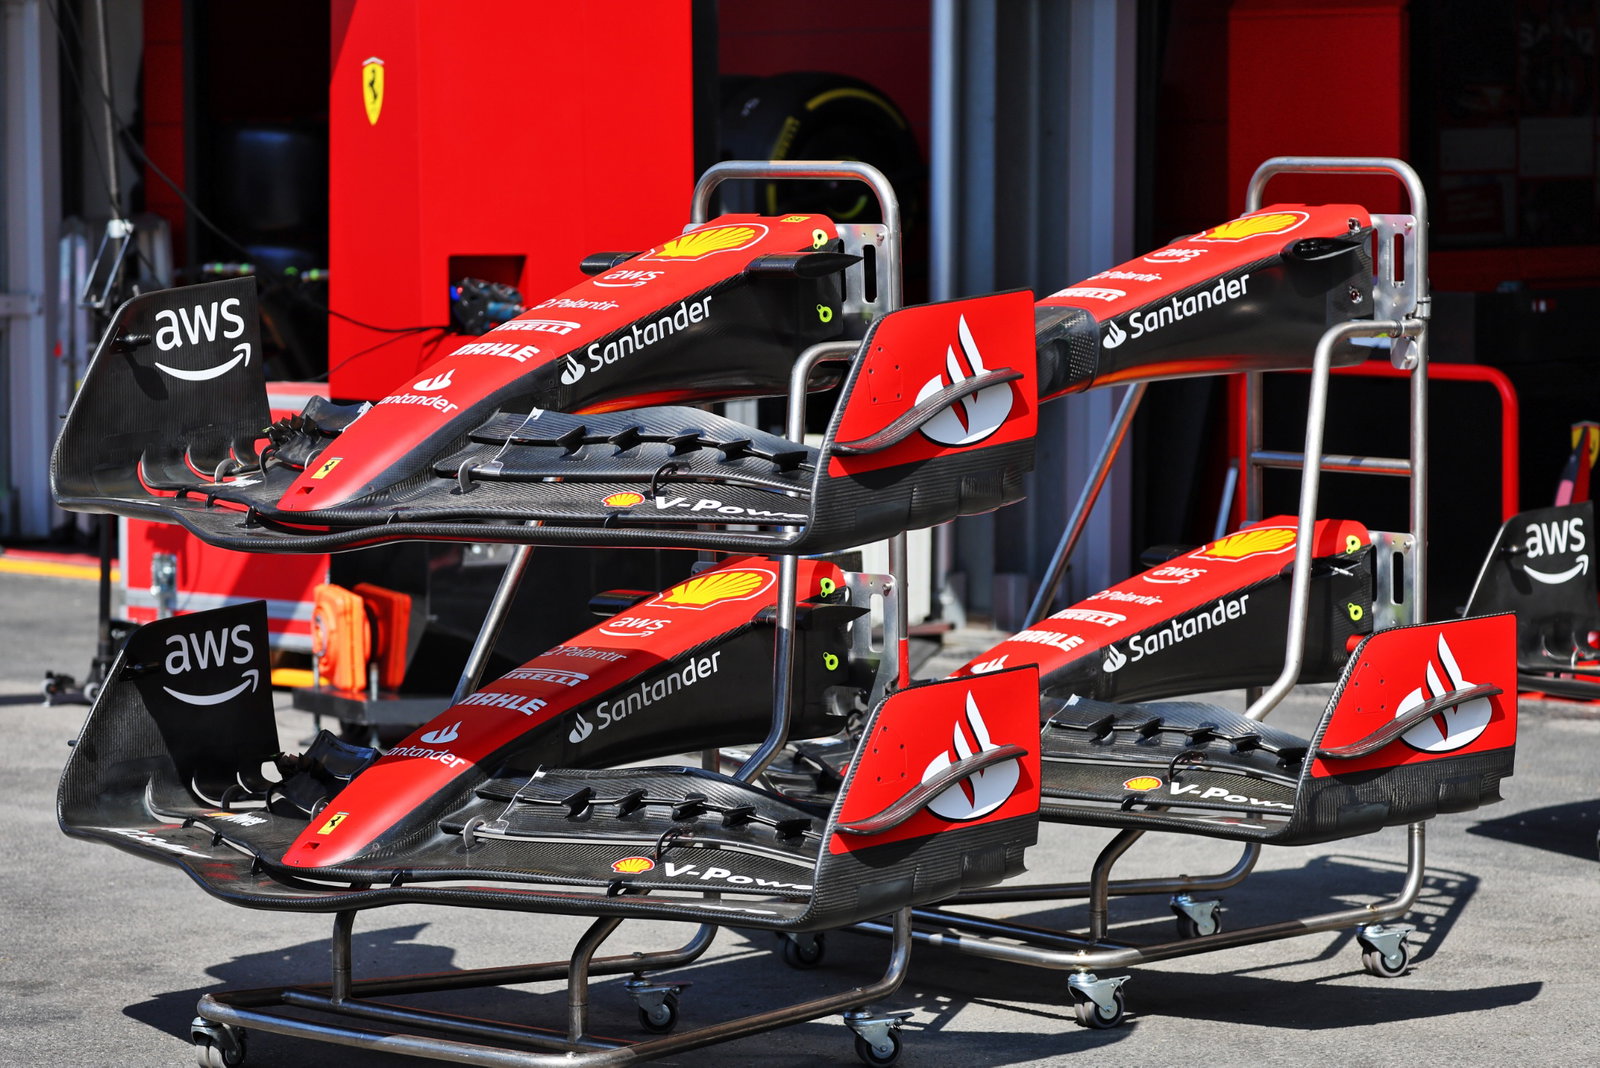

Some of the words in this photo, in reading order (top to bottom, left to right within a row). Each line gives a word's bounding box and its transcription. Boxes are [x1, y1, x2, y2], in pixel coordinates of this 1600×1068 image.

[1153, 248, 1208, 258] aws
[603, 270, 665, 280] aws
[1129, 274, 1250, 339] Santander
[155, 298, 245, 351] aws
[590, 296, 712, 373] Santander
[376, 392, 459, 413] antander
[655, 496, 809, 519] V-Powe
[1525, 517, 1586, 558] aws
[1152, 566, 1208, 579] aws
[609, 617, 672, 630] aws
[1129, 594, 1249, 662] Santander
[165, 624, 254, 675] aws
[597, 650, 721, 730] Santander
[457, 692, 548, 716] MAHLE
[385, 745, 466, 768] antander
[664, 862, 813, 890] V-Powe
